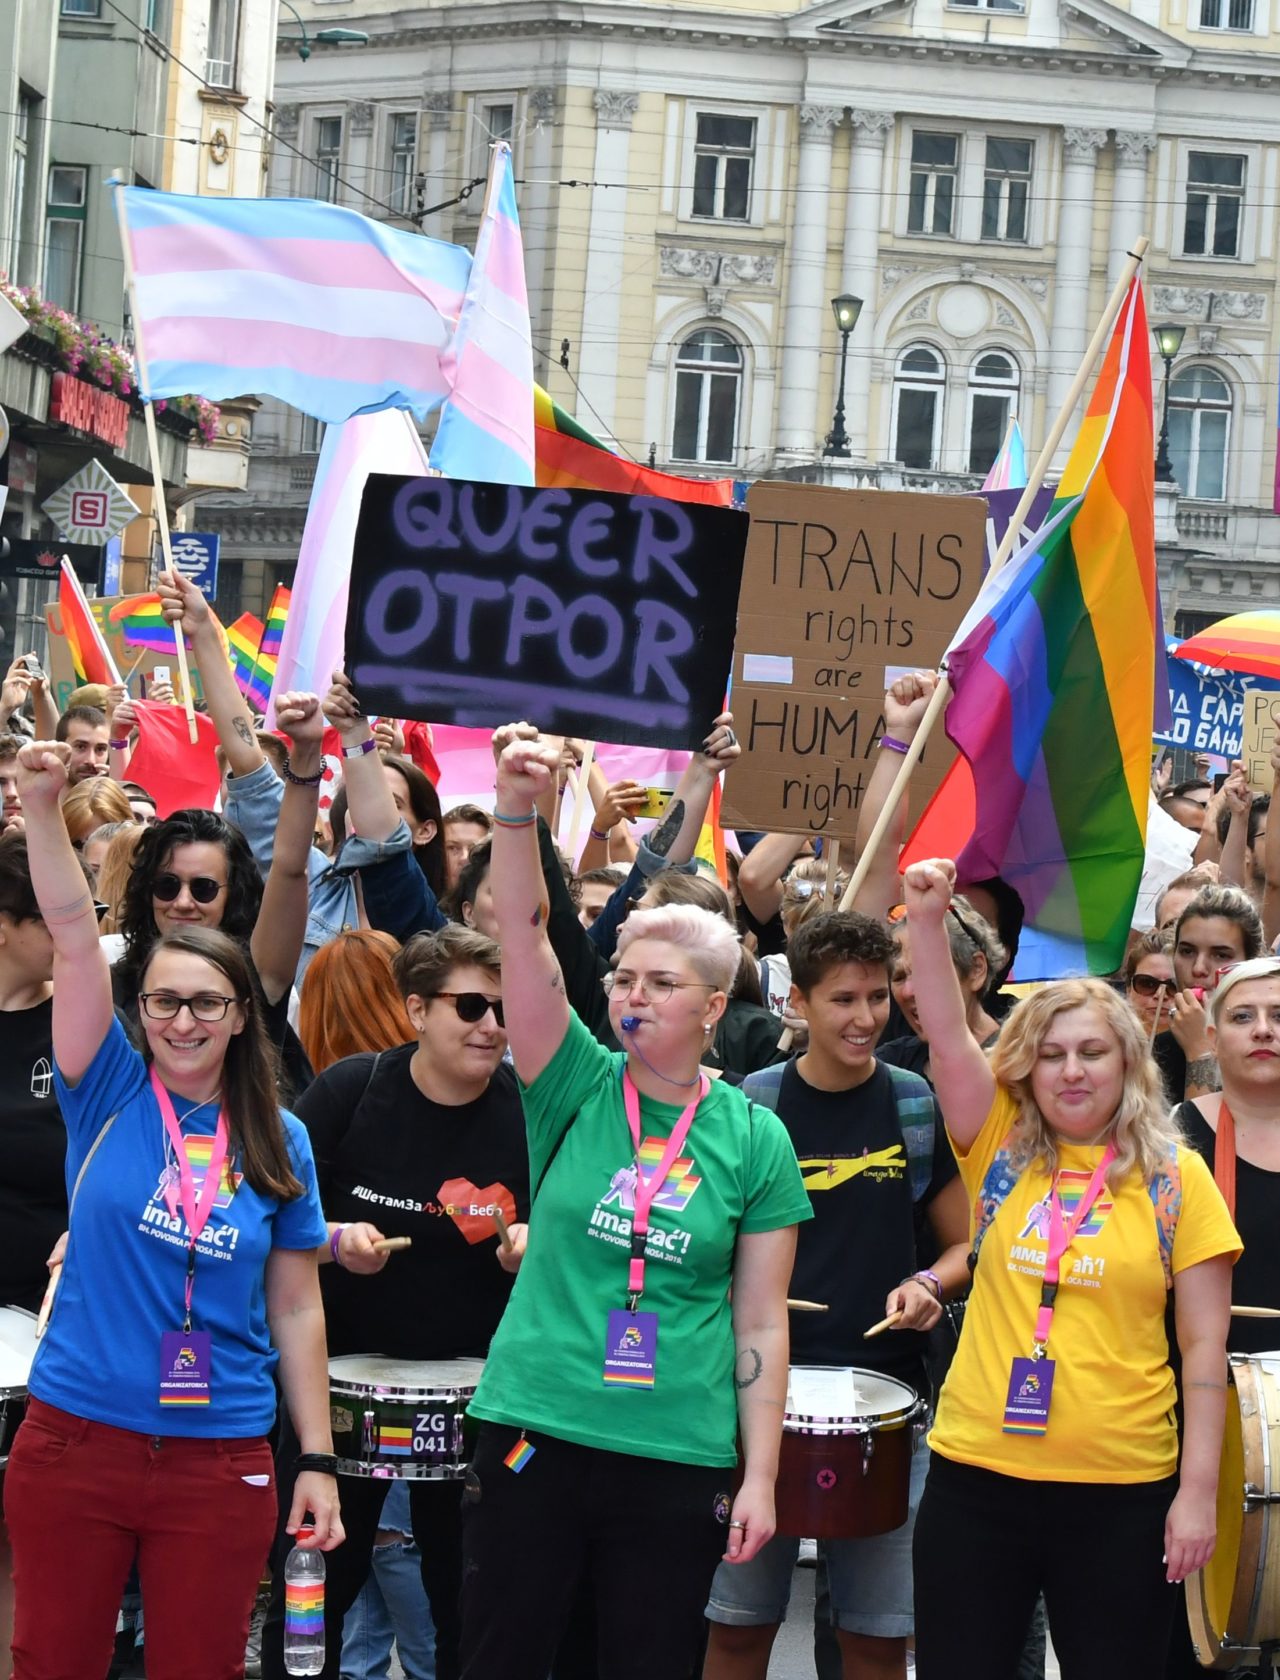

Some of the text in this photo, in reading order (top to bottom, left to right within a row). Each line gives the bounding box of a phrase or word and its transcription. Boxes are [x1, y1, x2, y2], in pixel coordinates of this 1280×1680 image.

[80, 499, 99, 520] S
[393, 477, 698, 597] QUEER
[754, 519, 962, 600] TRANS
[364, 569, 694, 703] OTPOR
[805, 604, 913, 661] rights
[814, 667, 862, 688] are
[1200, 694, 1244, 727] САР
[748, 699, 925, 764] HUMA
[782, 767, 865, 831] right
[142, 1199, 182, 1233] ima
[590, 1203, 632, 1236] ima
[599, 1230, 631, 1249] POVORK
[416, 1413, 446, 1432] ZG
[413, 1437, 447, 1453] 041
